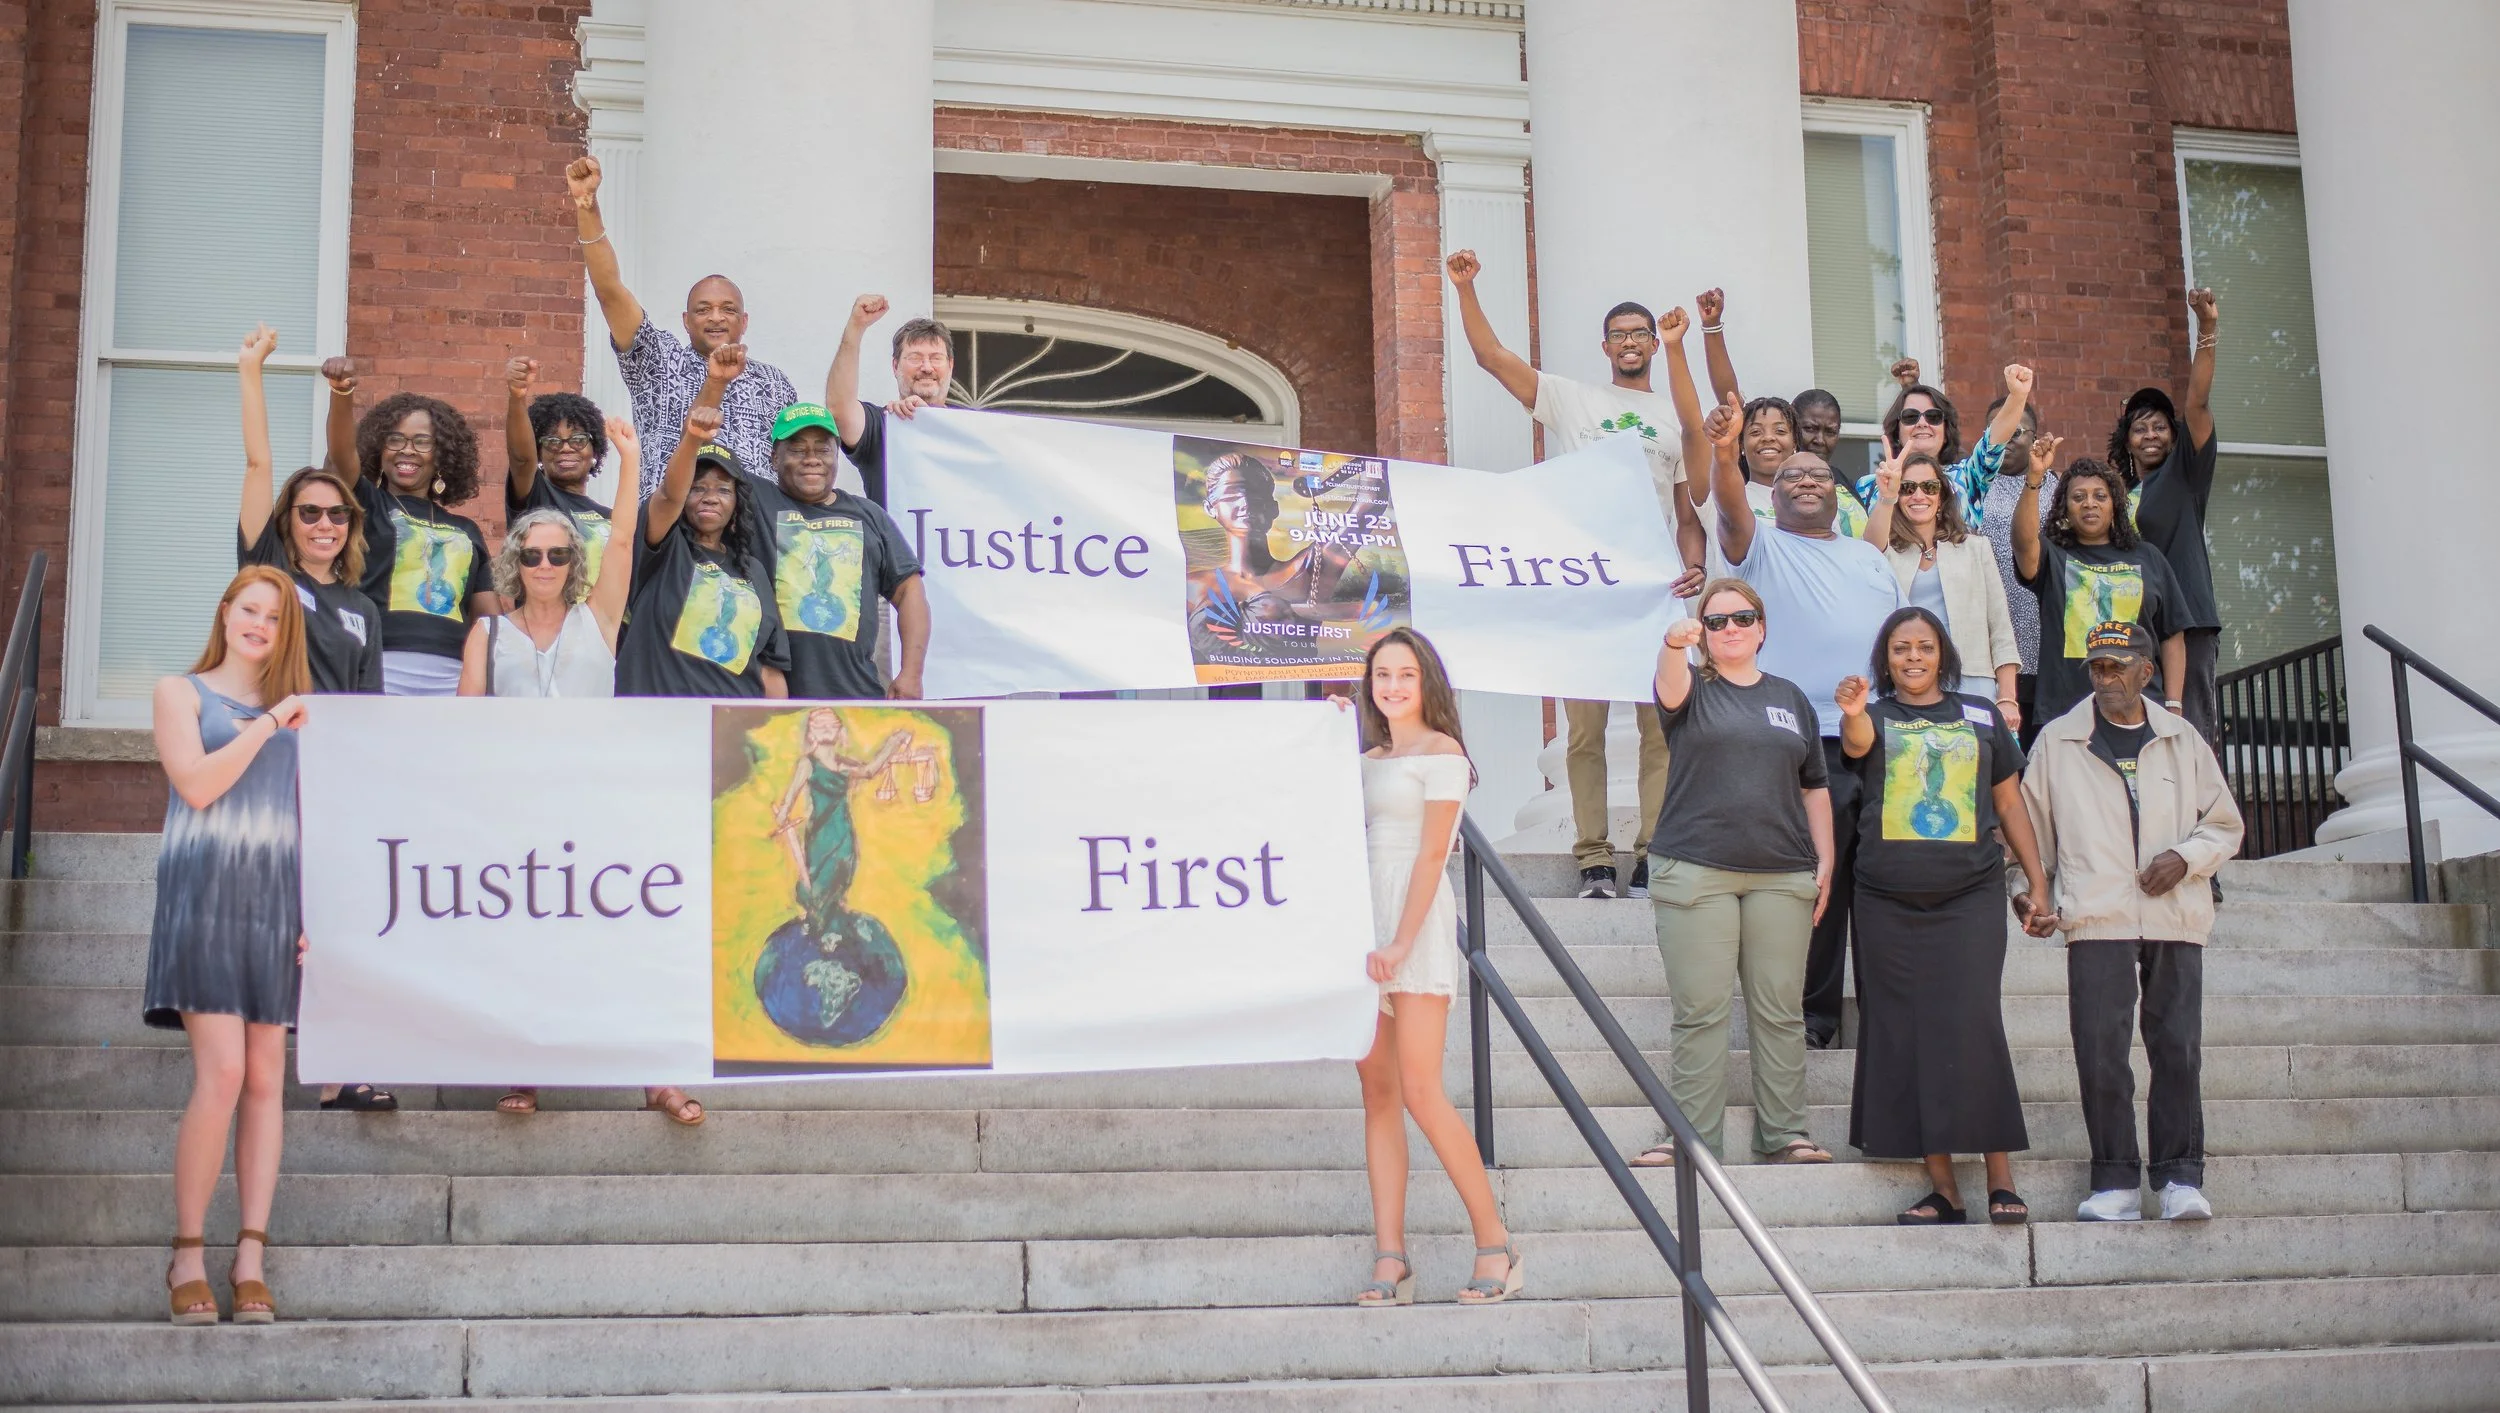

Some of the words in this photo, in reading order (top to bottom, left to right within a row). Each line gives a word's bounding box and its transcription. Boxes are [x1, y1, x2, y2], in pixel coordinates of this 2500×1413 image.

[785, 406, 810, 422] JUSTICE
[810, 406, 826, 417] FIRST
[826, 519, 854, 528] FIRST
[1304, 511, 1359, 528] JUNE
[1364, 515, 1392, 530] 23
[1289, 529, 1397, 547] 9AM-1PM
[907, 508, 1149, 579] Justice
[1449, 543, 1620, 588] First
[1243, 622, 1306, 636] JUSTICE
[1310, 625, 1352, 639] FIRST
[2089, 622, 2132, 638] KOREA
[1283, 640, 1317, 648] TOUR
[2088, 637, 2129, 649] VETERAN
[1209, 654, 1261, 664] BUILDING
[1265, 656, 1326, 664] SOLIDARITY
[376, 837, 685, 939] Justice
[1078, 834, 1290, 914] First
